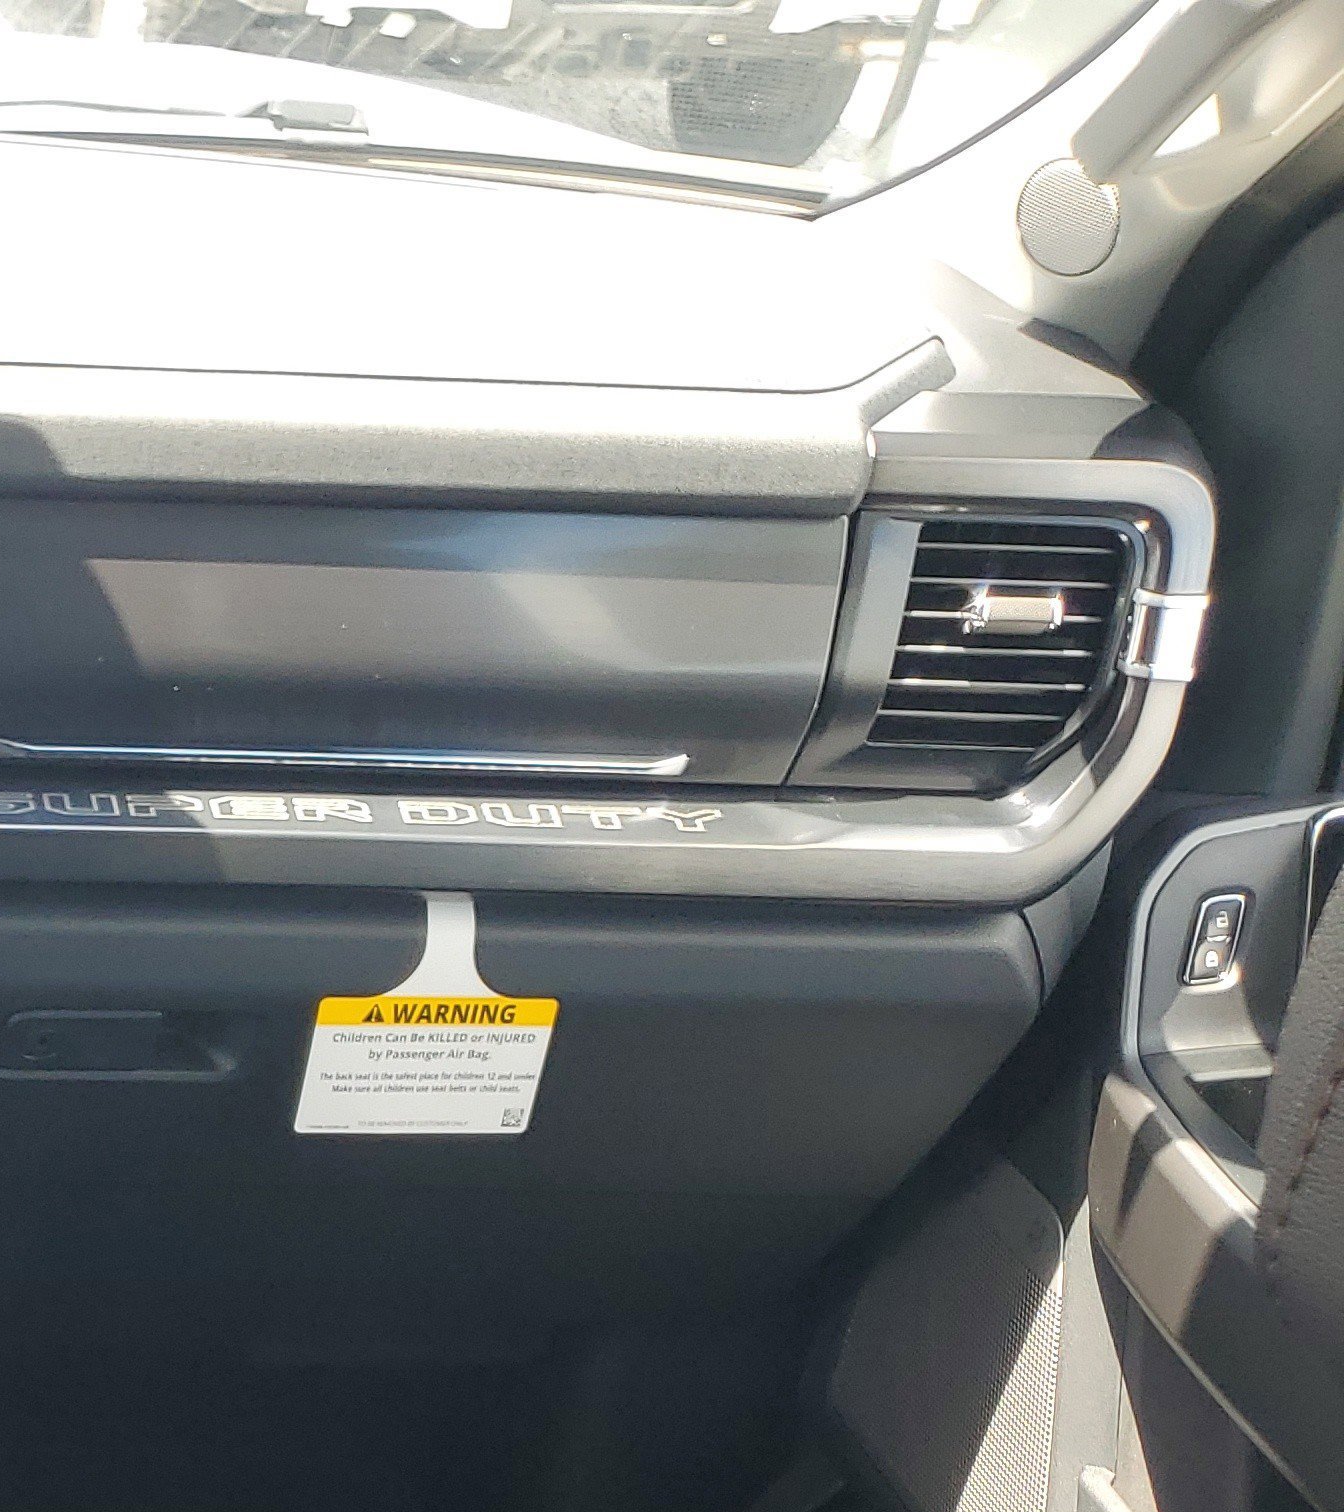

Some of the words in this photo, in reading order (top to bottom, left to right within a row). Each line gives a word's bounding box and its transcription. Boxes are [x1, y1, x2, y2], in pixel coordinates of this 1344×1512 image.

[398, 798, 723, 833] DUTY
[393, 1004, 517, 1024] WARNING
[333, 1033, 382, 1043] Children
[385, 1033, 408, 1043] Can
[410, 1033, 426, 1043] Be
[428, 1033, 468, 1043] KILLED
[470, 1035, 484, 1043] or
[486, 1033, 536, 1044] INJURED
[368, 1049, 382, 1061] by
[385, 1049, 444, 1061] Passenger
[446, 1049, 465, 1059] Air
[467, 1049, 491, 1061] Bag.
[419, 1073, 438, 1081] place
[331, 1085, 352, 1093] Make
[384, 1085, 414, 1093] children
